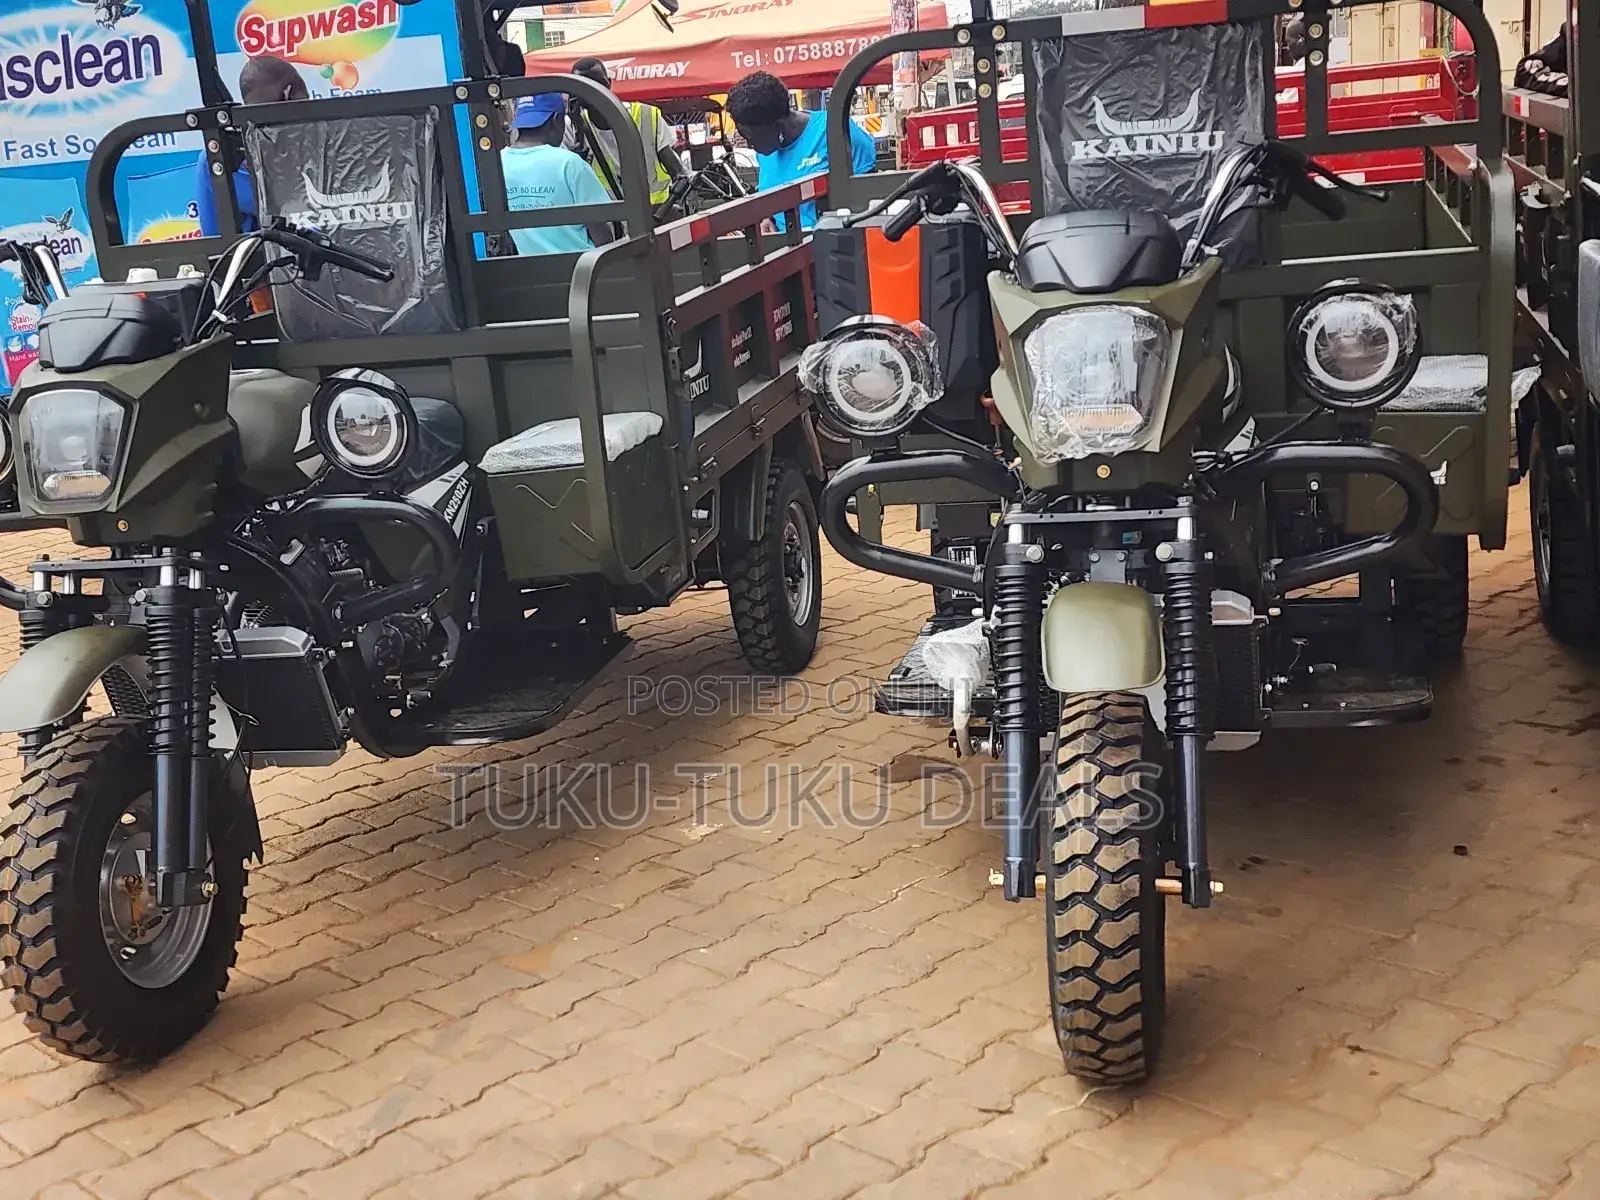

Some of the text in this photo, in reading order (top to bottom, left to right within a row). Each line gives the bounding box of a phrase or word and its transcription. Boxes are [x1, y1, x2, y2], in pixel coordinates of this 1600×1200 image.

[243, 0, 397, 53] Supwash
[0, 34, 162, 100] sclean
[602, 57, 691, 81] SINORAY
[3, 137, 59, 161] Fast
[65, 134, 97, 155] So
[1071, 130, 1226, 160] KAINIU
[530, 186, 556, 194] CLEAN
[288, 201, 415, 230] KAINIU
[12, 323, 37, 332] Remov
[9, 353, 27, 362] Hand
[689, 373, 710, 399] INIU
